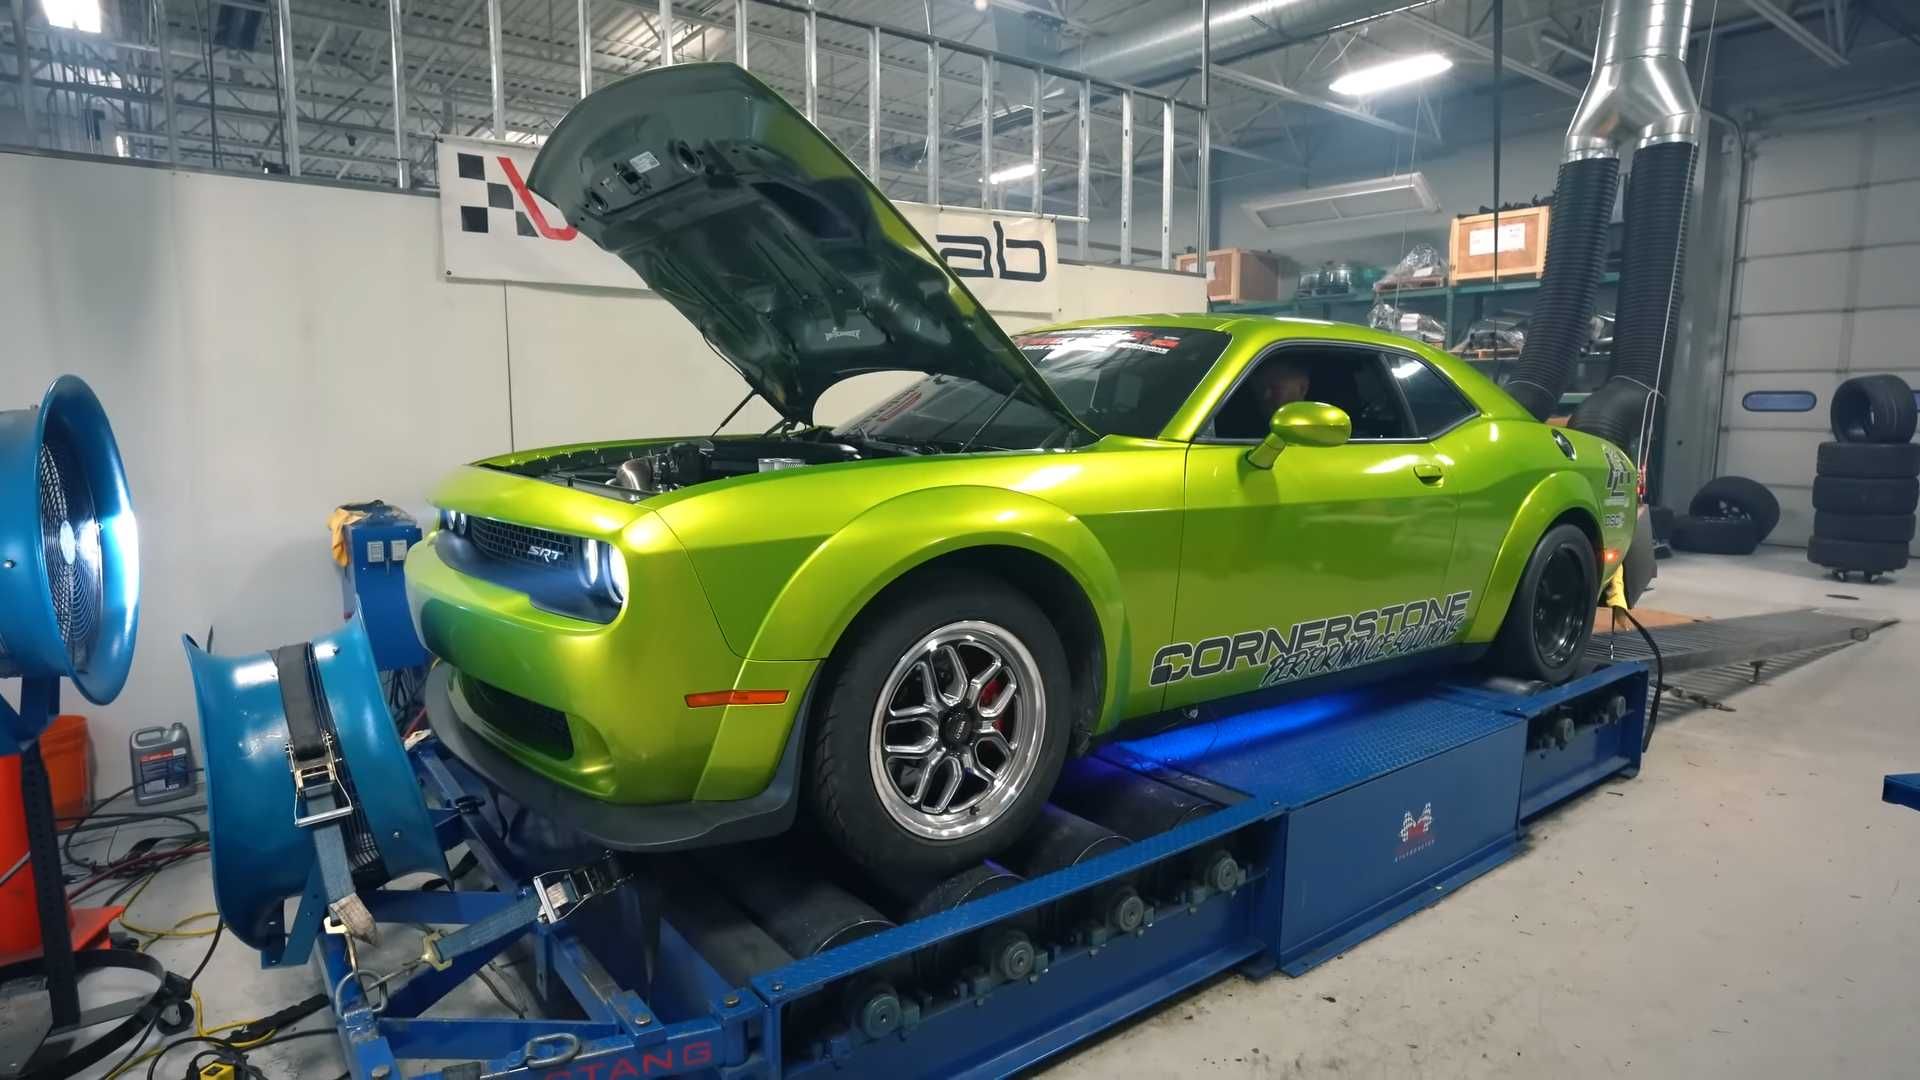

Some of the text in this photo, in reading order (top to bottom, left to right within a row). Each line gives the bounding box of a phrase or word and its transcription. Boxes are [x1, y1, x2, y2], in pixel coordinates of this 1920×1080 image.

[527, 545, 564, 563] SRT
[1150, 590, 1472, 687] CORNERSTONE
[1259, 614, 1466, 687] PERFORMANCE SOLUTIONS
